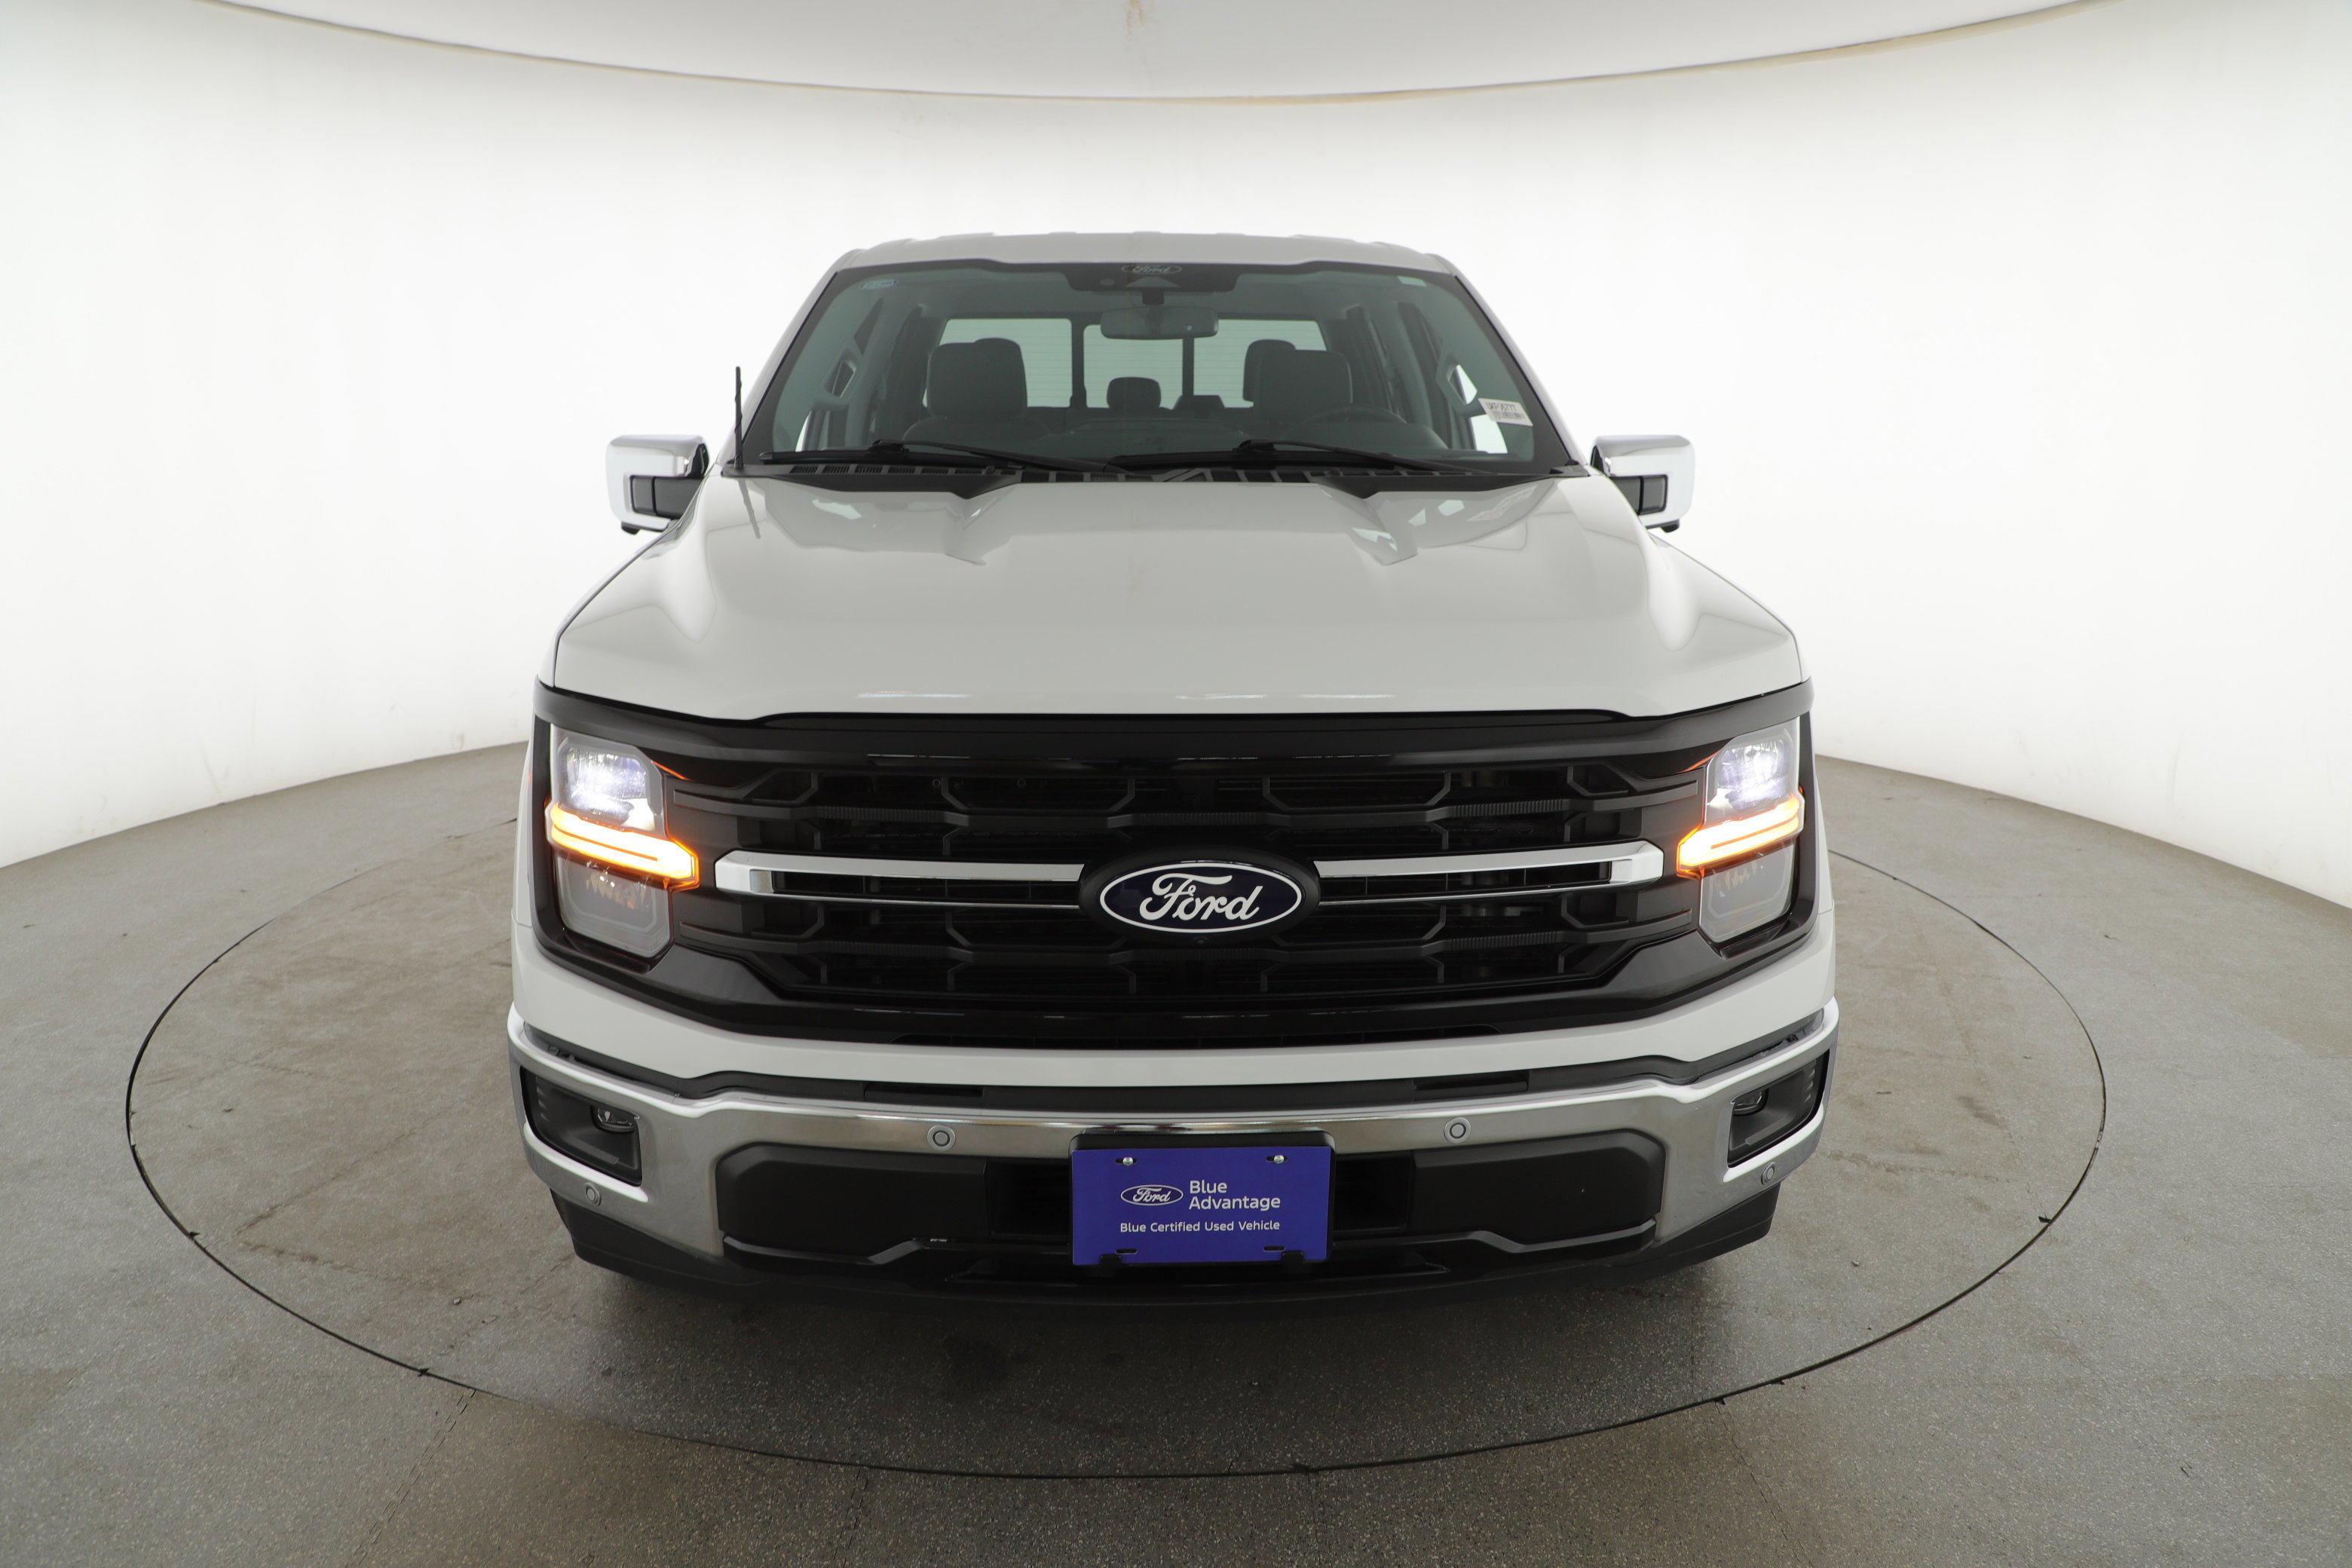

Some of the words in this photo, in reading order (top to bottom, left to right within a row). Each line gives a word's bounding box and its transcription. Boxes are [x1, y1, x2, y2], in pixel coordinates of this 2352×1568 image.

[1139, 873, 1263, 920] Ford
[1132, 1187, 1171, 1202] Ford
[1190, 1180, 1227, 1194] Blue
[1189, 1196, 1281, 1211] Advantage
[1120, 1223, 1147, 1233] Blue
[1150, 1221, 1200, 1232] Certified
[1205, 1221, 1234, 1231] Used
[1239, 1220, 1280, 1230] Vehicle
